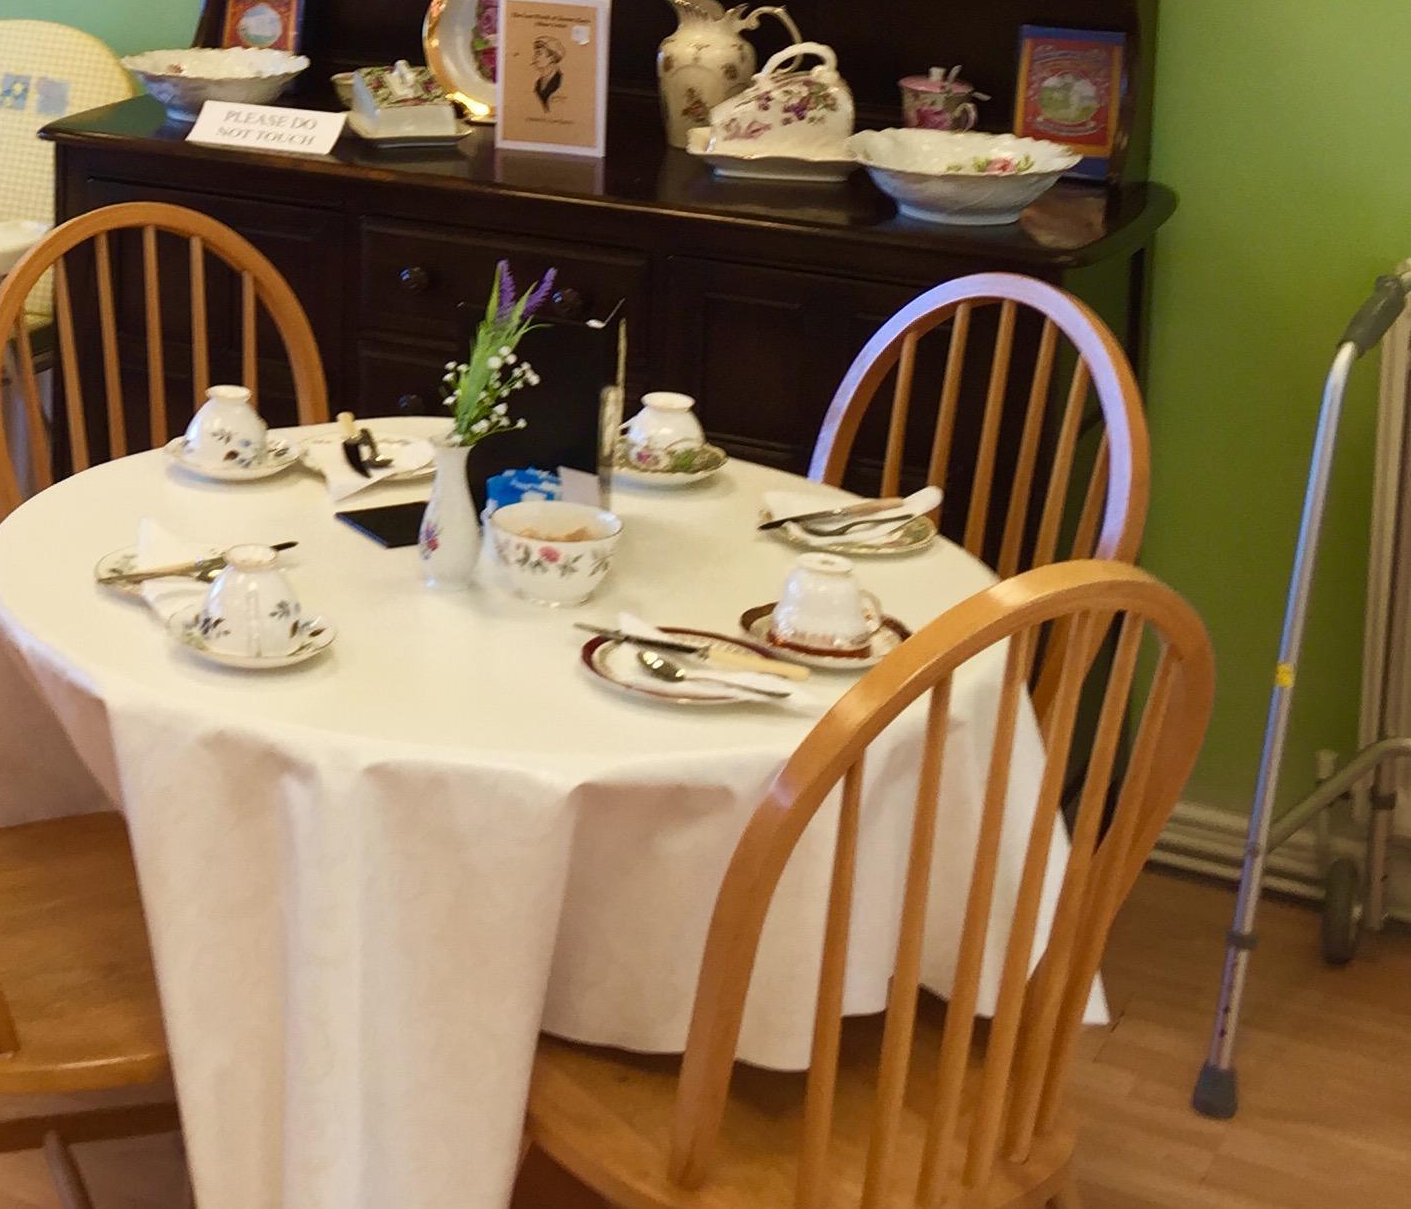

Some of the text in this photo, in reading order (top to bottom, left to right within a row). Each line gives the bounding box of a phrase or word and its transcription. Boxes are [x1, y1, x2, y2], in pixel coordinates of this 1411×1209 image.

[223, 110, 318, 131] PLEASE DO
[216, 127, 316, 146] NOT TOUCH
